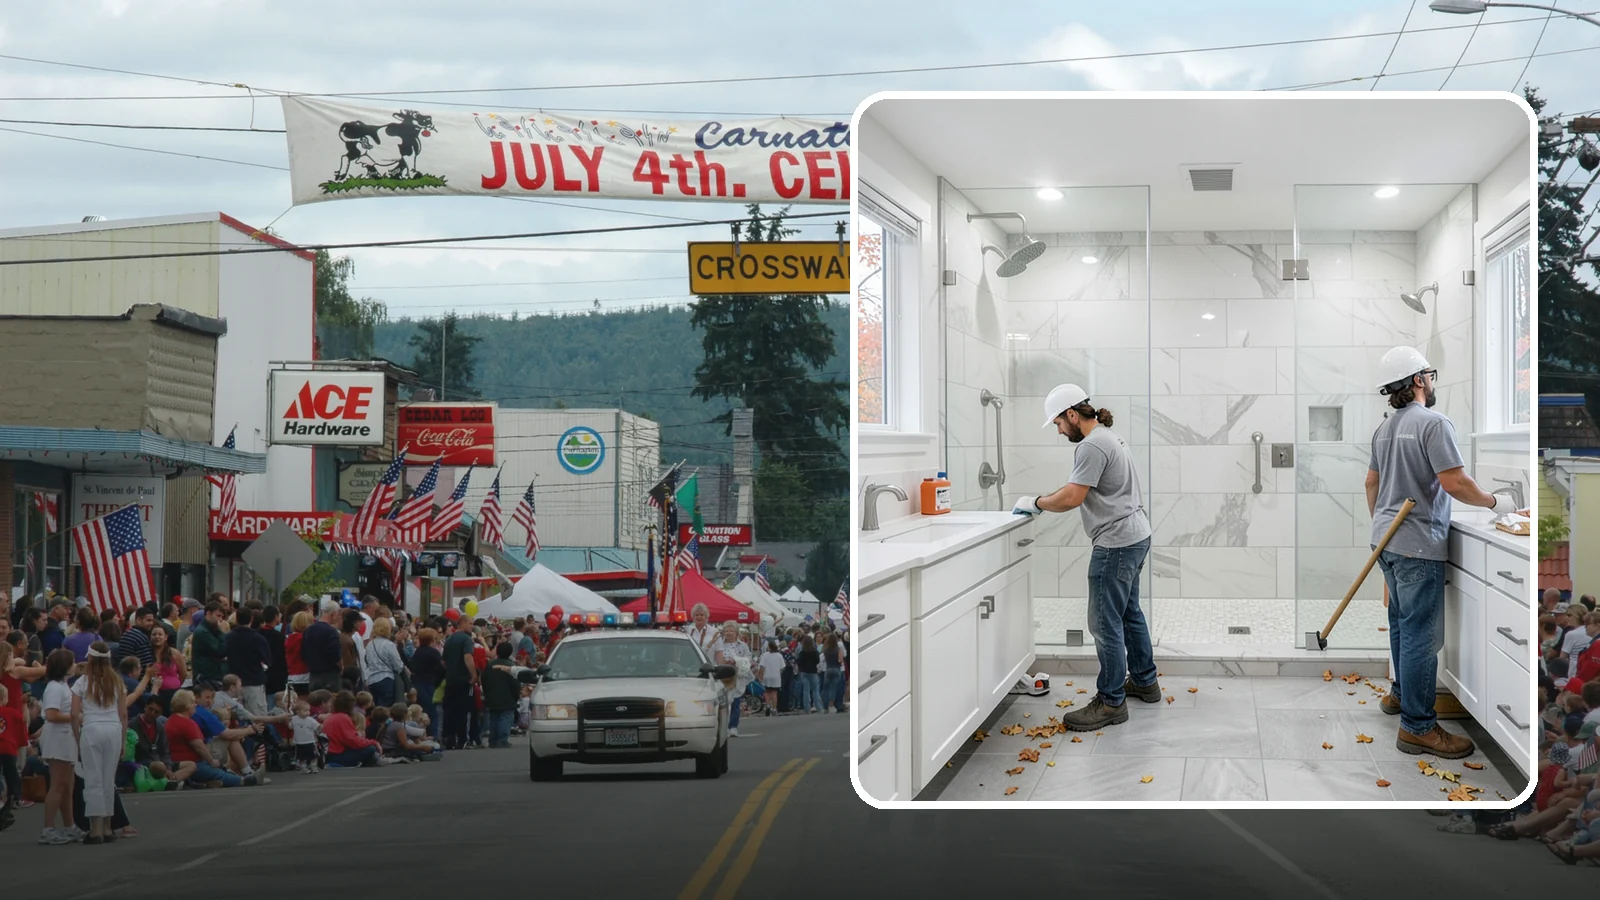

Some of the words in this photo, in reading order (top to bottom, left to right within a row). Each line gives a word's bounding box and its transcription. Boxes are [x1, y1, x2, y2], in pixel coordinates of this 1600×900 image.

[481, 141, 605, 192] JULY
[632, 150, 747, 197] 4th.
[697, 254, 850, 280] CROSSWA
[283, 380, 373, 420] ACE
[406, 409, 452, 422] CEDAR
[461, 409, 485, 421] LOG
[283, 421, 371, 436] Hardware
[416, 428, 476, 447] Coca-Cola
[354, 467, 385, 478] Simpl
[83, 485, 93, 494] St.
[96, 486, 124, 494] Vincent
[126, 486, 135, 494] de
[137, 486, 155, 495] Paul
[688, 526, 741, 535] CRNATION
[699, 535, 730, 543] GLASS
